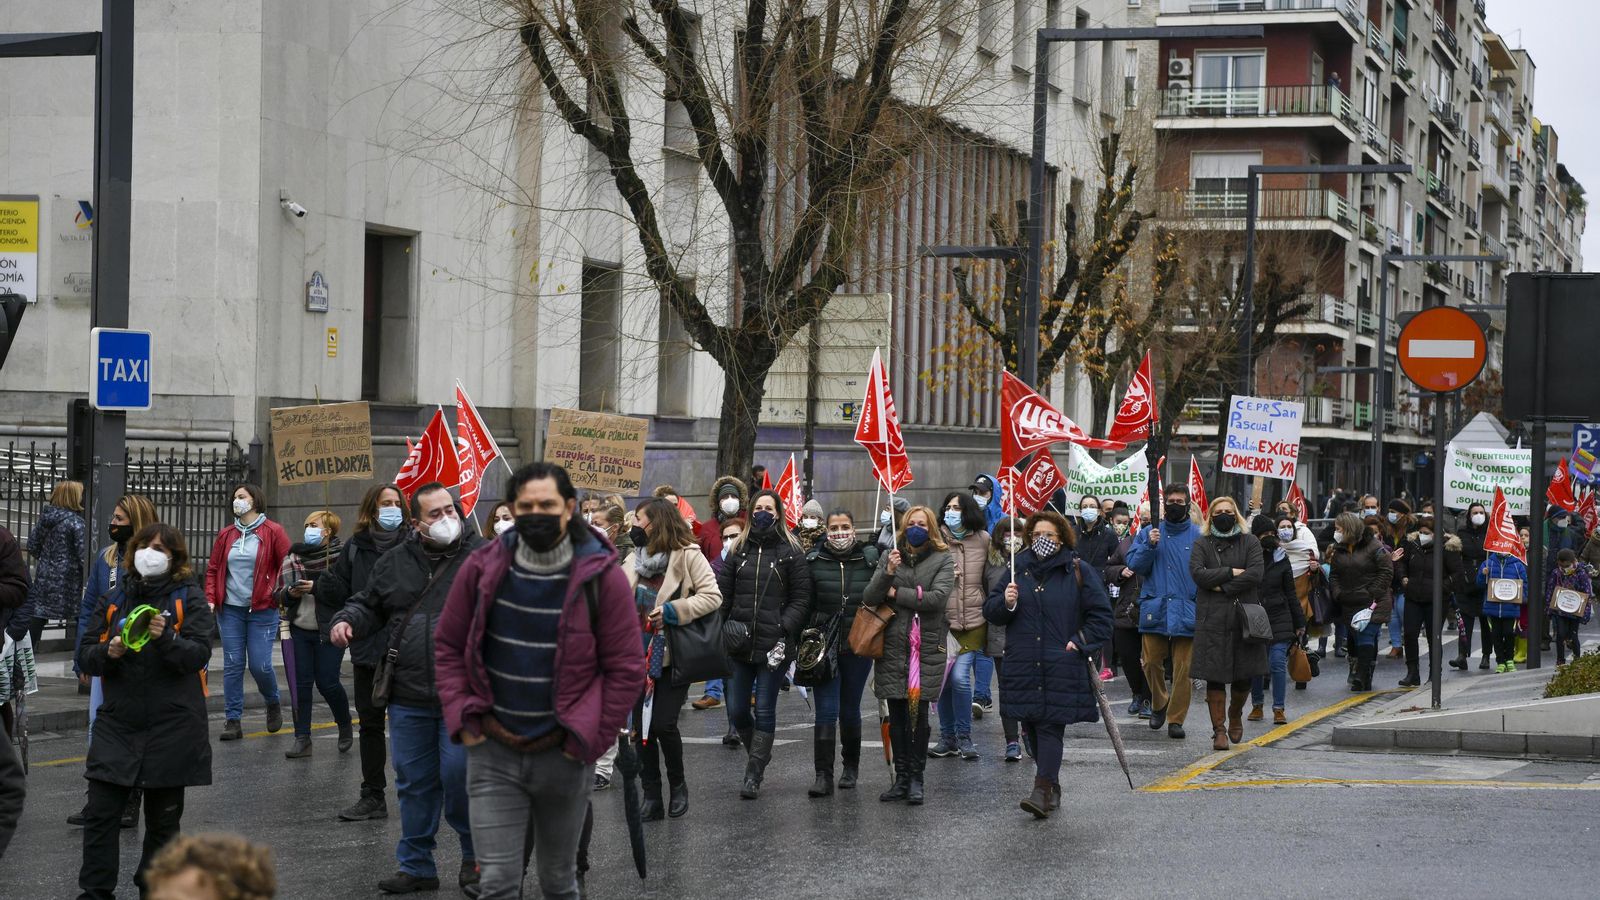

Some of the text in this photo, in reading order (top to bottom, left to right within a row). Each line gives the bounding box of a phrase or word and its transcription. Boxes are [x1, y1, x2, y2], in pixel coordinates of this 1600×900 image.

[100, 358, 148, 382] TAXI
[1019, 402, 1081, 434] UGT
[1270, 402, 1296, 418] San
[1231, 411, 1273, 433] Pascual
[304, 436, 370, 455] CALIDAD
[1577, 430, 1592, 448] P
[1258, 439, 1298, 458] EXIGE
[281, 454, 372, 481] #COMEDORYA
[564, 460, 623, 475] DE CALIDAD
[1223, 453, 1294, 477] COMEDOR YA
[1454, 459, 1531, 474] SIN COMEDOR
[1471, 473, 1513, 484] NO HAY
[1068, 482, 1138, 495] IGNORADAS
[1509, 502, 1523, 510] YA!
